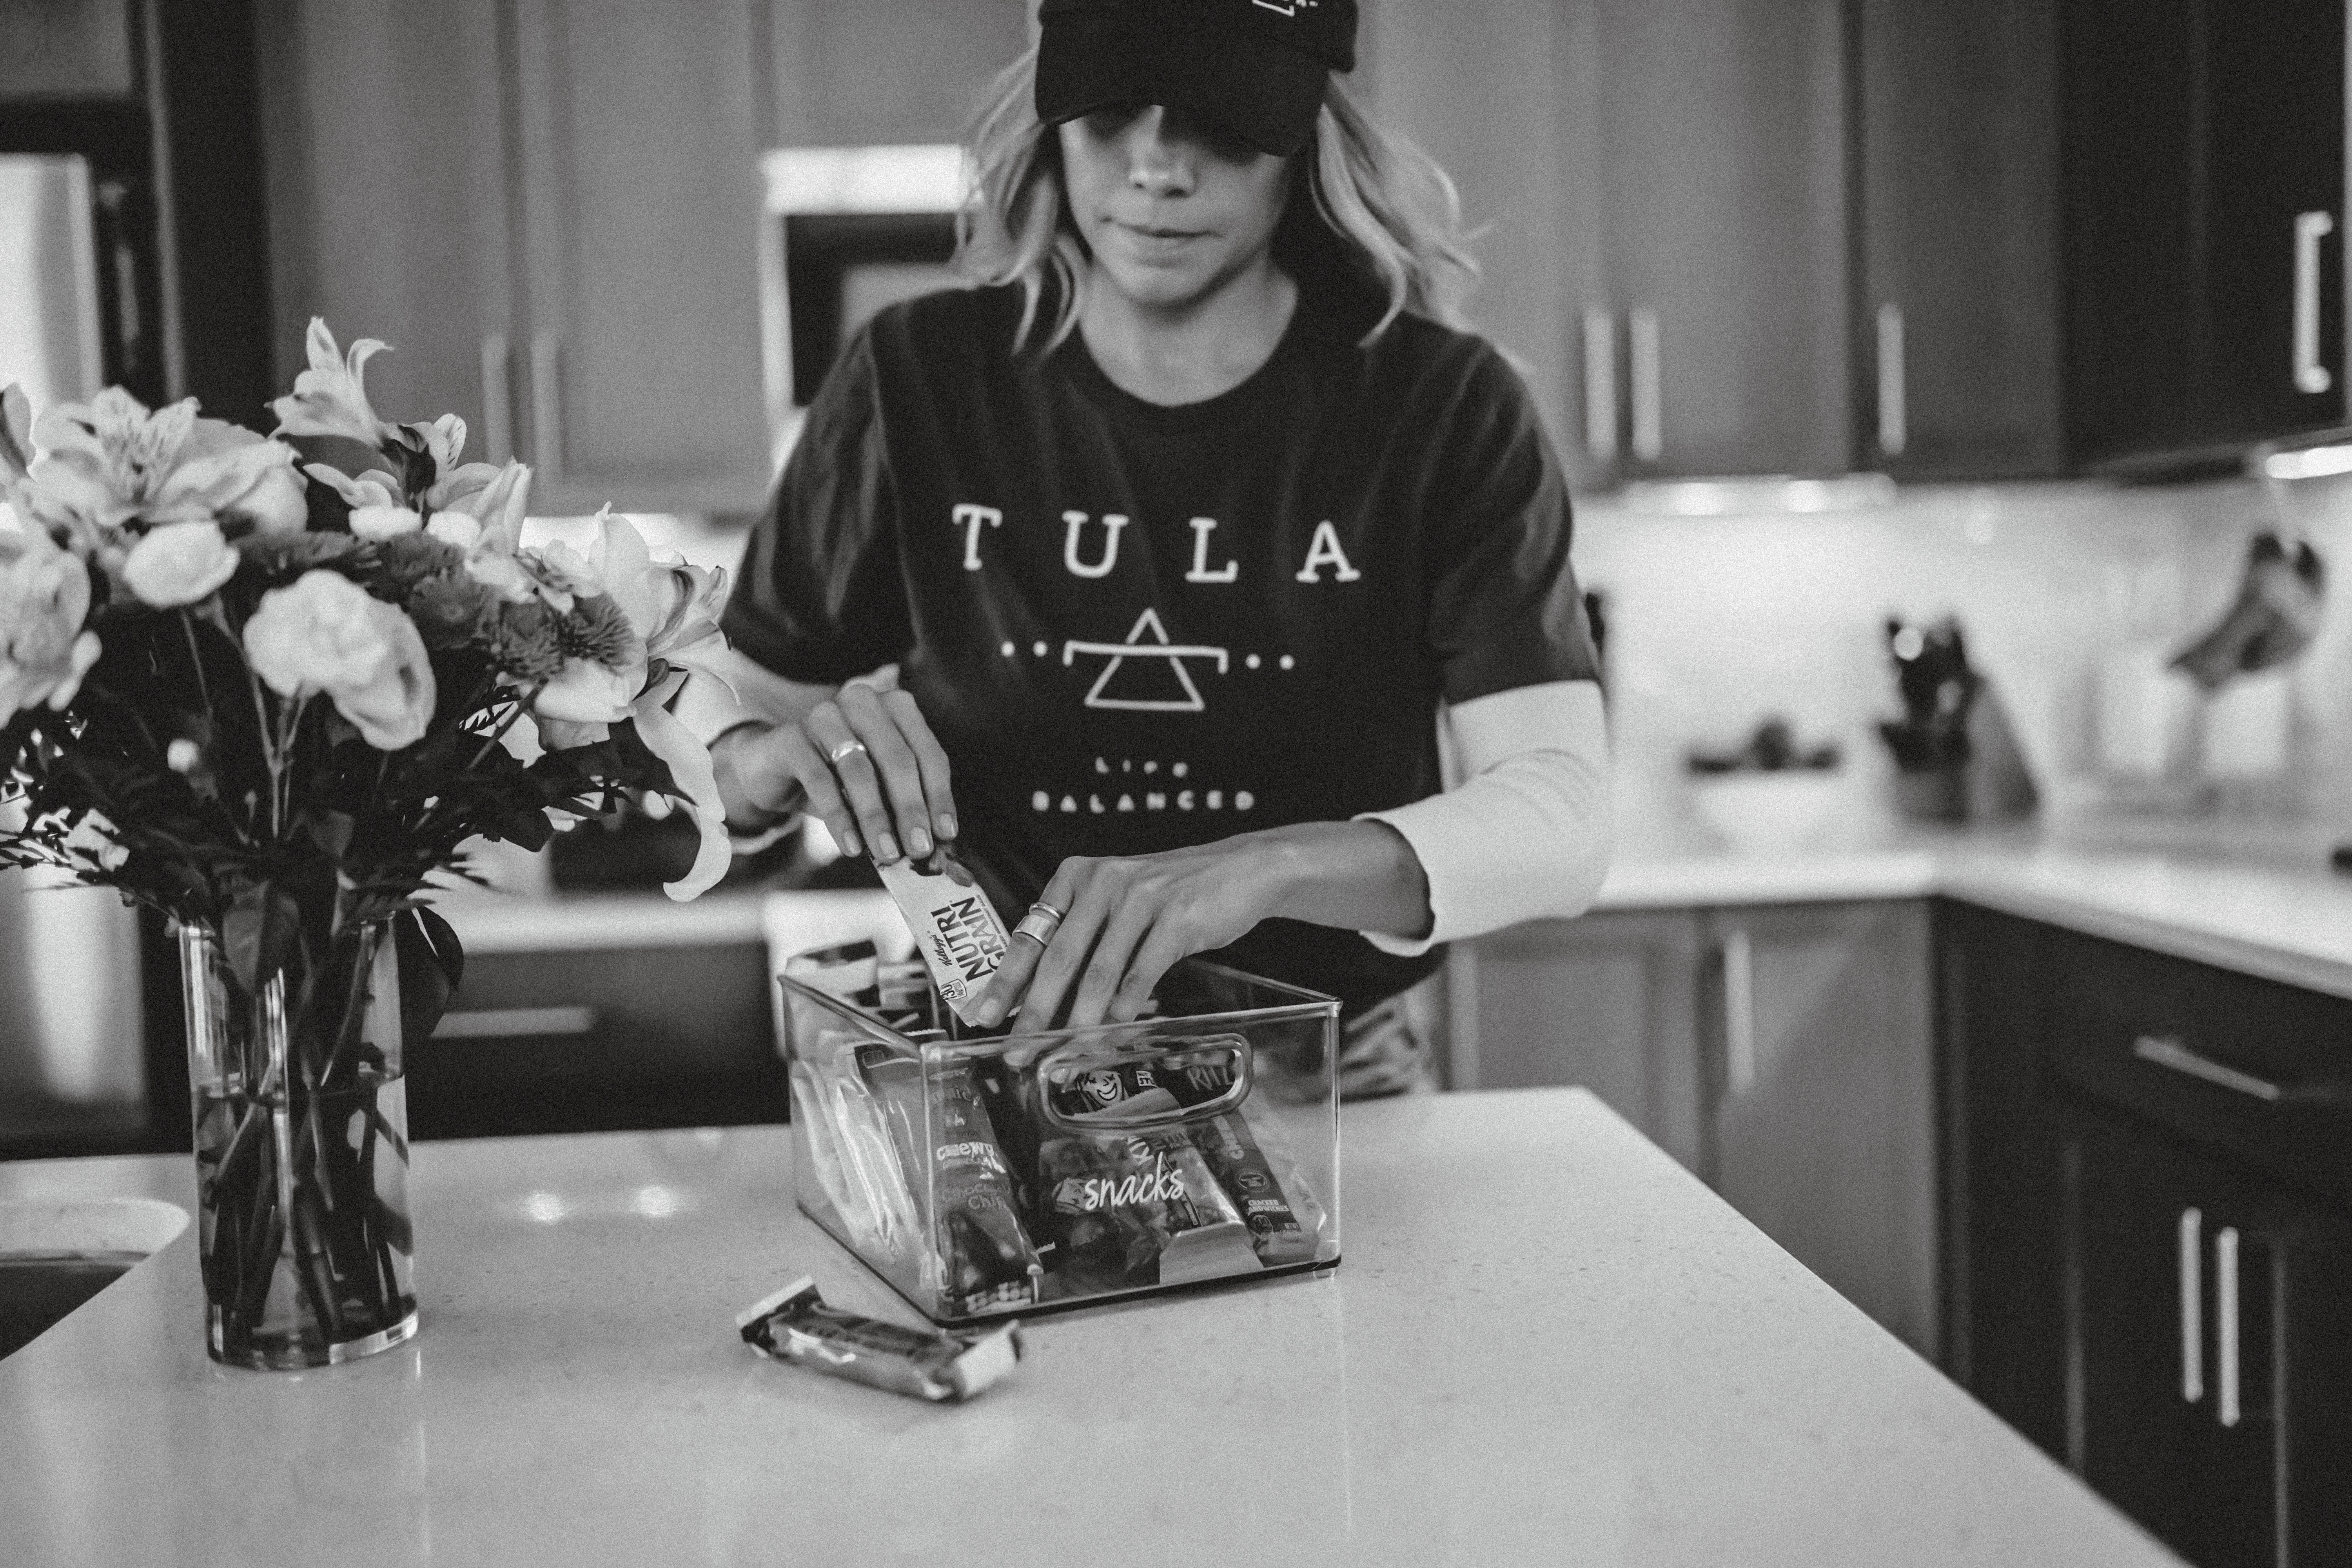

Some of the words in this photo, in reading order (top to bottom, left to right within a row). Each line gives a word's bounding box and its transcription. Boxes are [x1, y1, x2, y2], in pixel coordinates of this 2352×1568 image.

[952, 503, 1361, 583] TULA
[1032, 790, 1254, 813] BALANCED
[931, 906, 993, 982] NUTRI
[951, 897, 1005, 970] GRAIN
[1085, 1151, 1184, 1211] snacks
